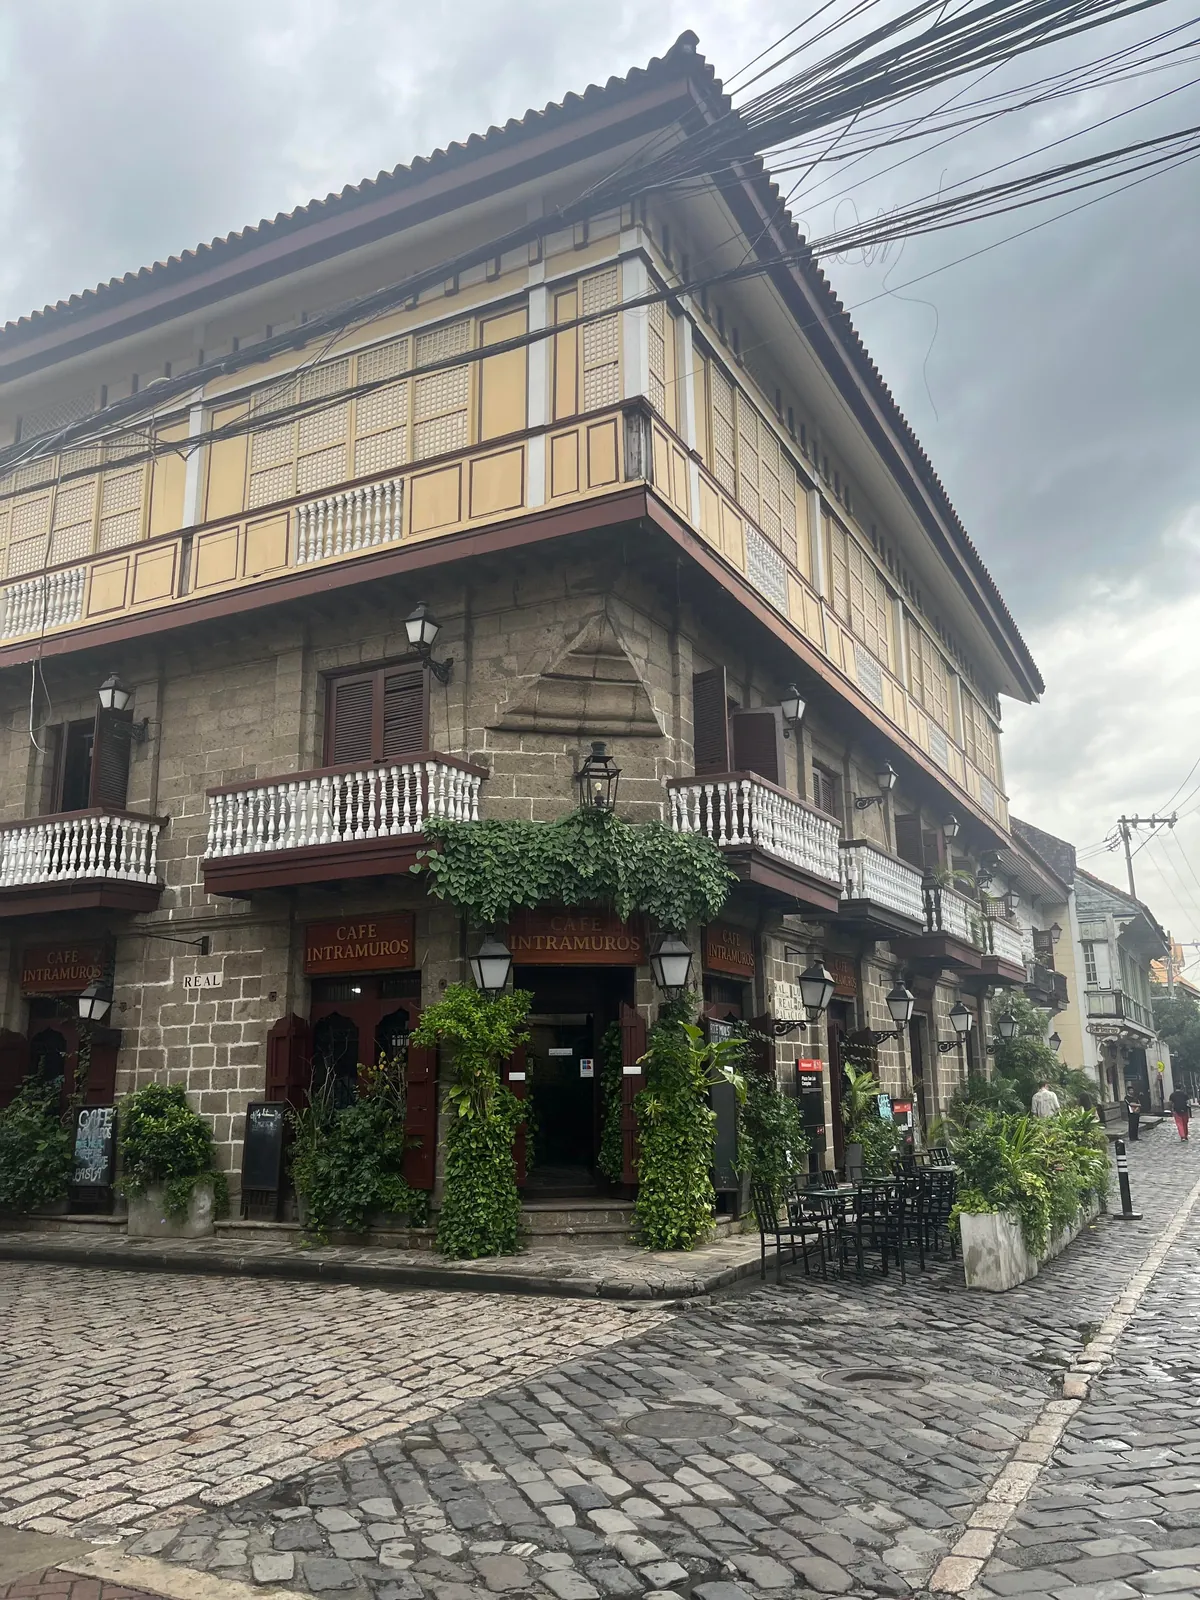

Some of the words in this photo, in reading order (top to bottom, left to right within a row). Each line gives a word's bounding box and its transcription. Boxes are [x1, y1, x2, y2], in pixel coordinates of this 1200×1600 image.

[336, 924, 377, 940] CAFE
[550, 917, 602, 931] CAFE
[510, 935, 640, 950] INTRAMUROS
[722, 929, 740, 947] CAFE
[47, 950, 79, 964] CAFE
[307, 940, 409, 961] INTRAMUROS
[709, 943, 754, 967] INTRAMUROS
[23, 964, 102, 982] INTRAMUROS
[184, 975, 221, 988] REAL
